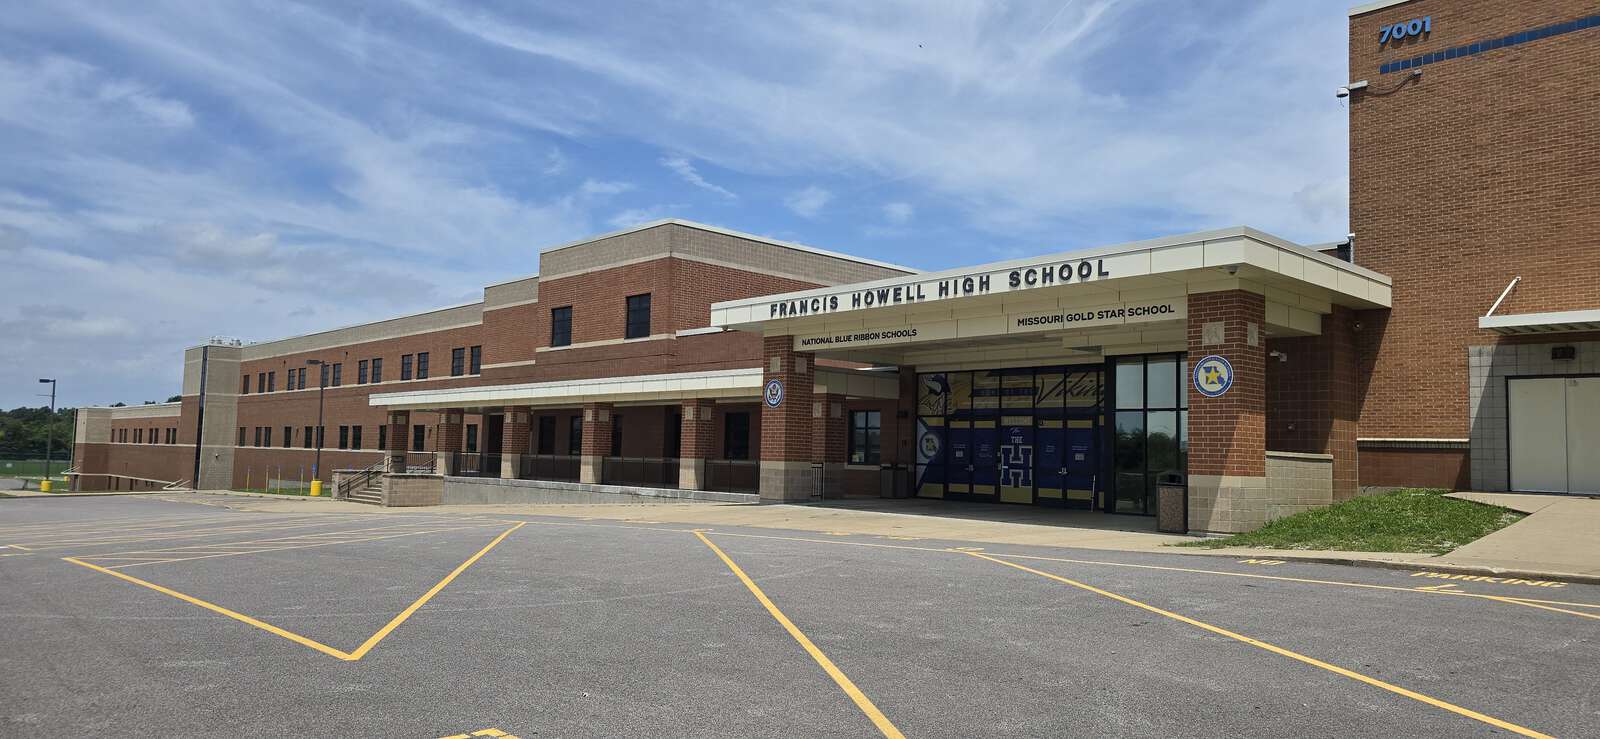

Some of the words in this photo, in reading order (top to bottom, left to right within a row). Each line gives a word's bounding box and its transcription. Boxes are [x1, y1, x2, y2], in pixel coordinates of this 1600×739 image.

[1379, 15, 1431, 44] 7001
[770, 296, 839, 318] FRANCIS
[852, 284, 926, 308] HOWELL
[938, 275, 990, 297] HIGH
[1008, 259, 1110, 289] SCHOOL
[1017, 314, 1064, 327] MISSOURI
[1066, 311, 1095, 322] GOLD
[1097, 308, 1125, 320] STAR
[1128, 304, 1175, 317] SCHOOL
[801, 337, 834, 346] NATIONAL
[835, 334, 853, 343] BLUE
[853, 332, 880, 342] RIBBON
[881, 328, 917, 339] SCHOOLS
[1411, 572, 1568, 588] PARKING
